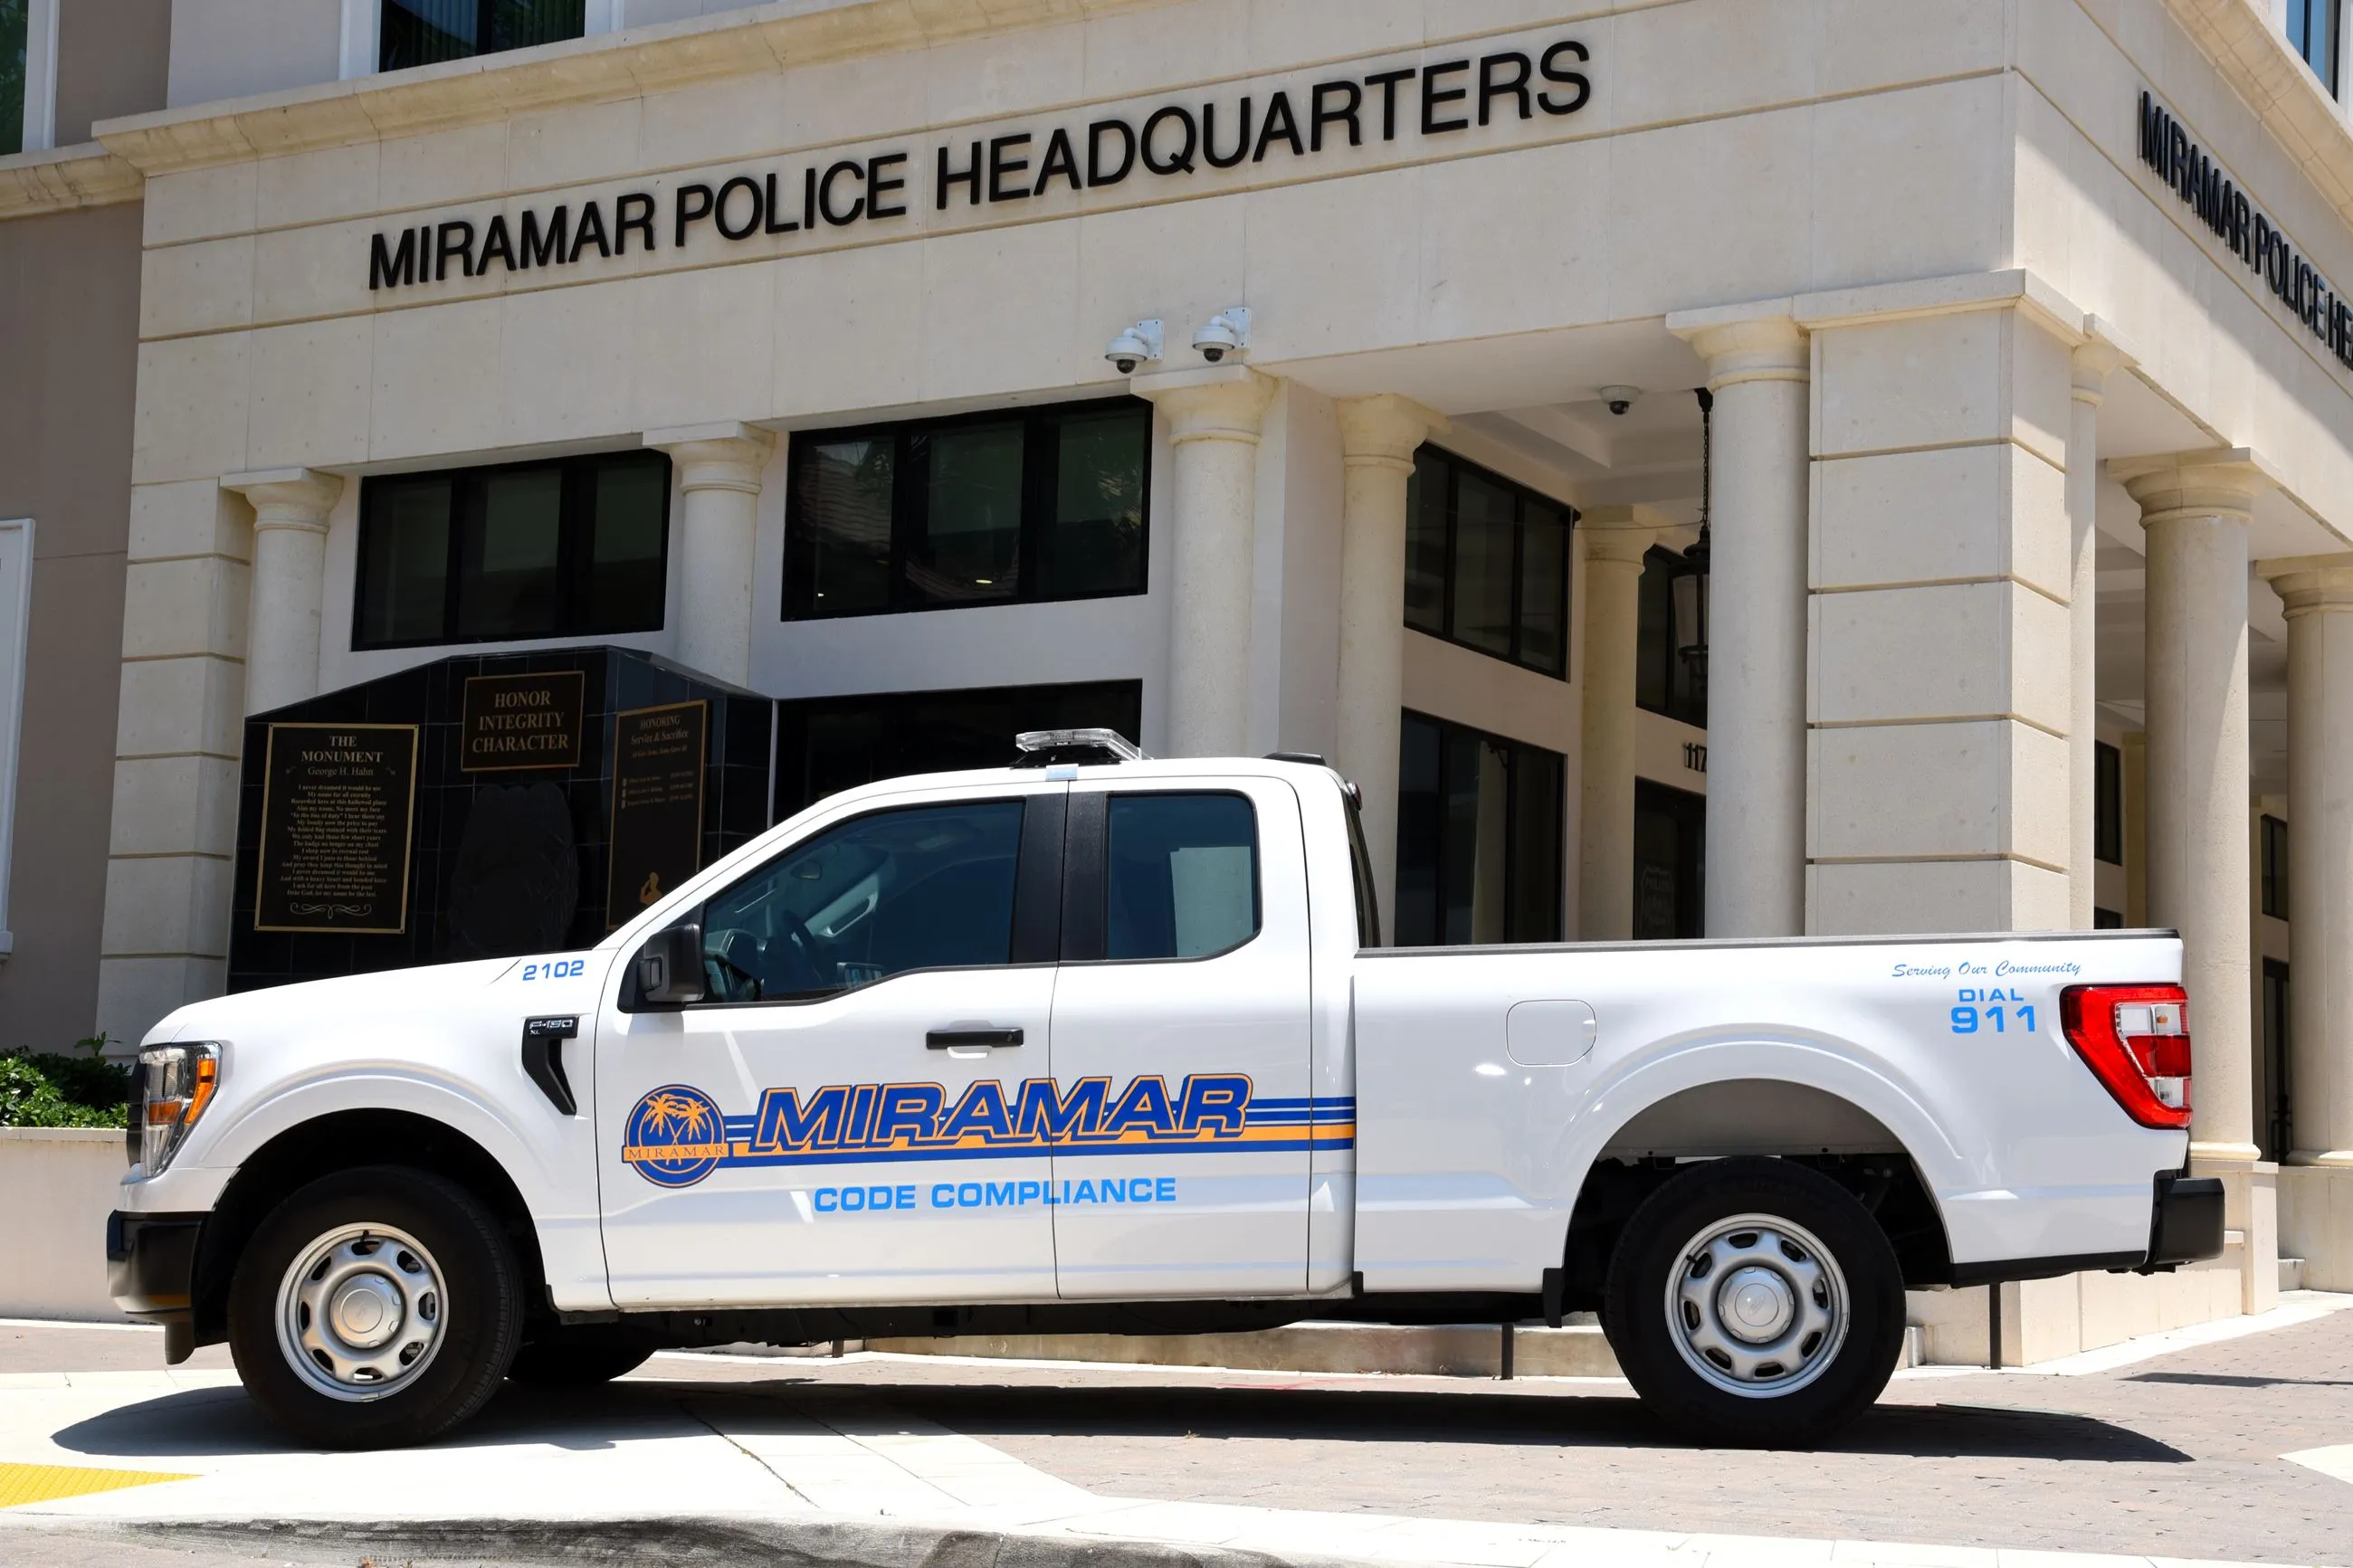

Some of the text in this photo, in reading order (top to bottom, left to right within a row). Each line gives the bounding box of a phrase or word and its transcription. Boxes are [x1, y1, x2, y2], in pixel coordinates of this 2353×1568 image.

[369, 40, 1591, 290] MIRAMAR POLICE HEADQUARTERS
[2140, 90, 2353, 370] MIRAMAR POLICE HE
[494, 690, 551, 708] HONOR
[478, 711, 565, 731] INTEGRITY
[640, 715, 681, 730] HONORING
[329, 736, 357, 747] THE
[472, 734, 569, 753] CHARACTER
[300, 750, 384, 763] MONUMENT
[308, 765, 374, 777] George H. Hahn
[522, 959, 585, 982] 2102
[1891, 959, 2082, 980] Serving Our Community
[1958, 988, 2025, 1003] DIAL
[529, 1019, 574, 1030] F-150
[1951, 1005, 2036, 1034] 911
[625, 1072, 1254, 1162] MIRAMAR MIRAMAR
[814, 1177, 1177, 1212] CODE COMPLIANCE
